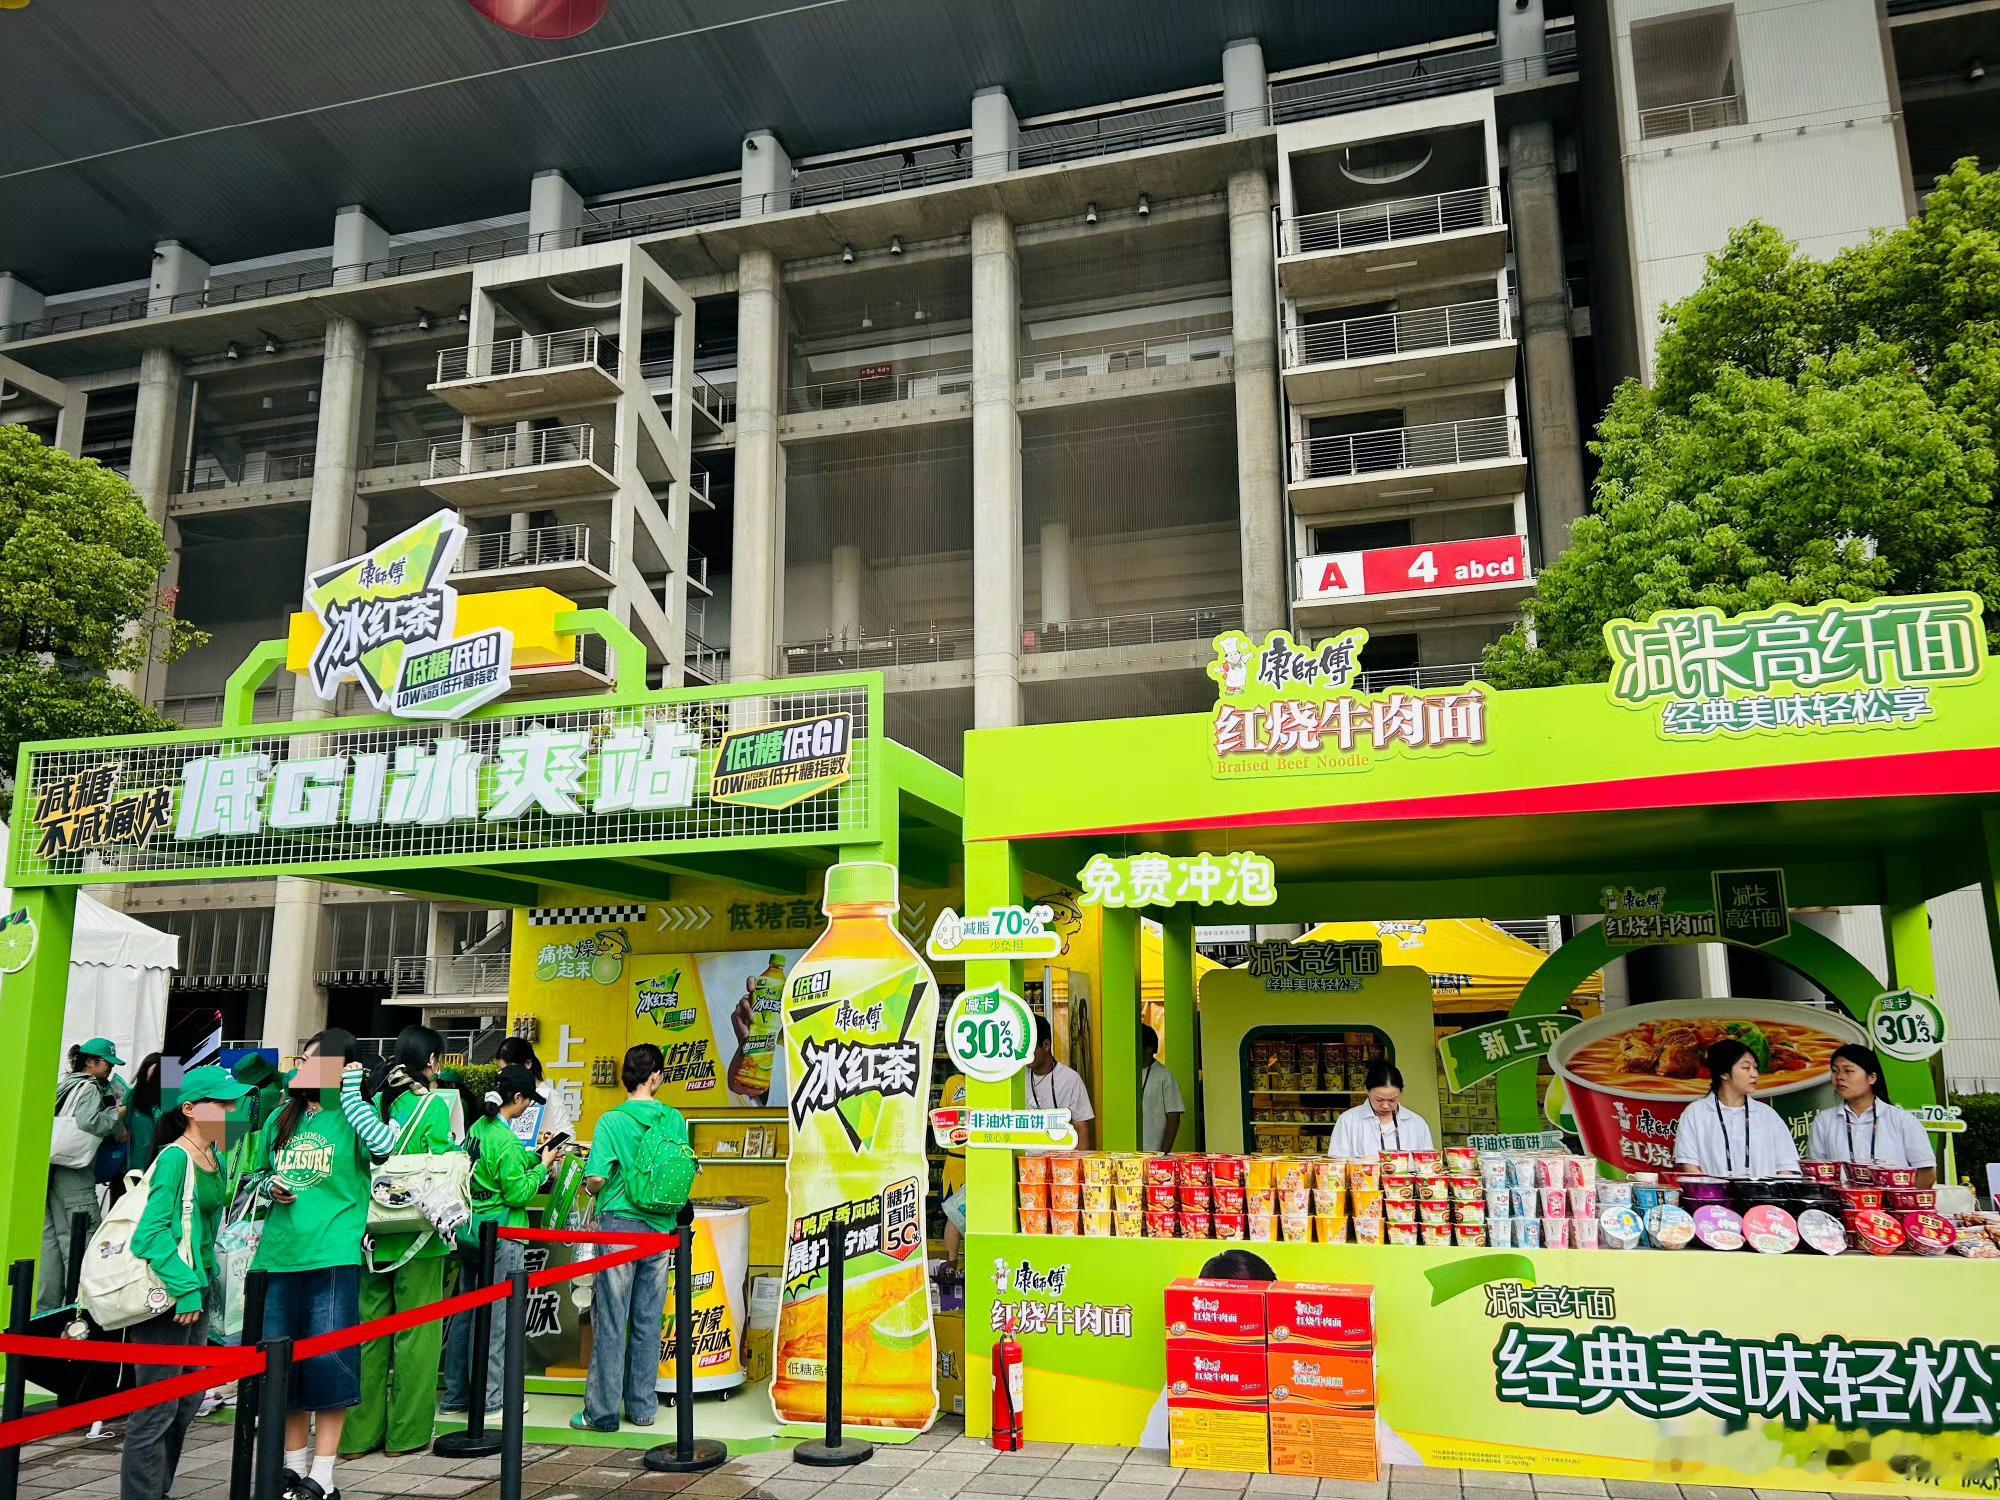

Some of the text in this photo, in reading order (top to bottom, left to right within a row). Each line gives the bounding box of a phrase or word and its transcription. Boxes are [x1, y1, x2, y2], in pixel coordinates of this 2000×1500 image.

[1318, 551, 1515, 591] A 4 abcd
[317, 593, 441, 680] 冰红茶
[1615, 601, 1977, 699] 减卡高纤面
[405, 635, 498, 688] 低糖低GI
[396, 687, 421, 709] LOW
[440, 667, 498, 696] 低升糖指数
[1213, 688, 1486, 756] 红烧牛肉面
[1661, 687, 1932, 735] 经典美味轻松享
[725, 718, 844, 772] 低糖低GI
[1217, 753, 1370, 774] Braised Beef Noodle
[33, 763, 119, 823] 减糖
[173, 722, 700, 841] 低GI冰爽站
[713, 775, 745, 797] LOW
[744, 777, 769, 790] INDEX
[769, 757, 846, 787] 低升糖指数
[35, 785, 173, 859] 不减痛快
[1080, 856, 1274, 905] 免费冲泡
[1732, 884, 1769, 907] 减卡
[963, 910, 1040, 936] 减脂 70%
[1606, 914, 1715, 937] 红烧牛肉面
[1725, 908, 1781, 929] 高纤面
[990, 938, 1025, 952] 少负担
[1250, 943, 1379, 977] 减卡高纤面
[557, 961, 593, 981] 起来
[793, 972, 830, 999] 低GI
[1266, 977, 1362, 993] 经典美味轻松享
[637, 993, 678, 1017] 冰红茶
[965, 996, 995, 1014] 减卡
[1477, 1019, 1561, 1062] 新上市
[796, 1041, 917, 1109] 冰红茶
[970, 1113, 1045, 1130] 非油炸面饼
[1468, 1133, 1541, 1151] 非油炸面饼
[886, 1181, 916, 1208] 糖分
[802, 1198, 881, 1237] 鸭屎香风味
[885, 1204, 917, 1229] 直降
[886, 1222, 921, 1252] 50%
[990, 1300, 1133, 1337] 红烧牛肉面
[1485, 1283, 1617, 1320] 减卡高纤面
[787, 1362, 826, 1378] 低糖高
[1498, 1326, 2000, 1425] 经典美味轻松
